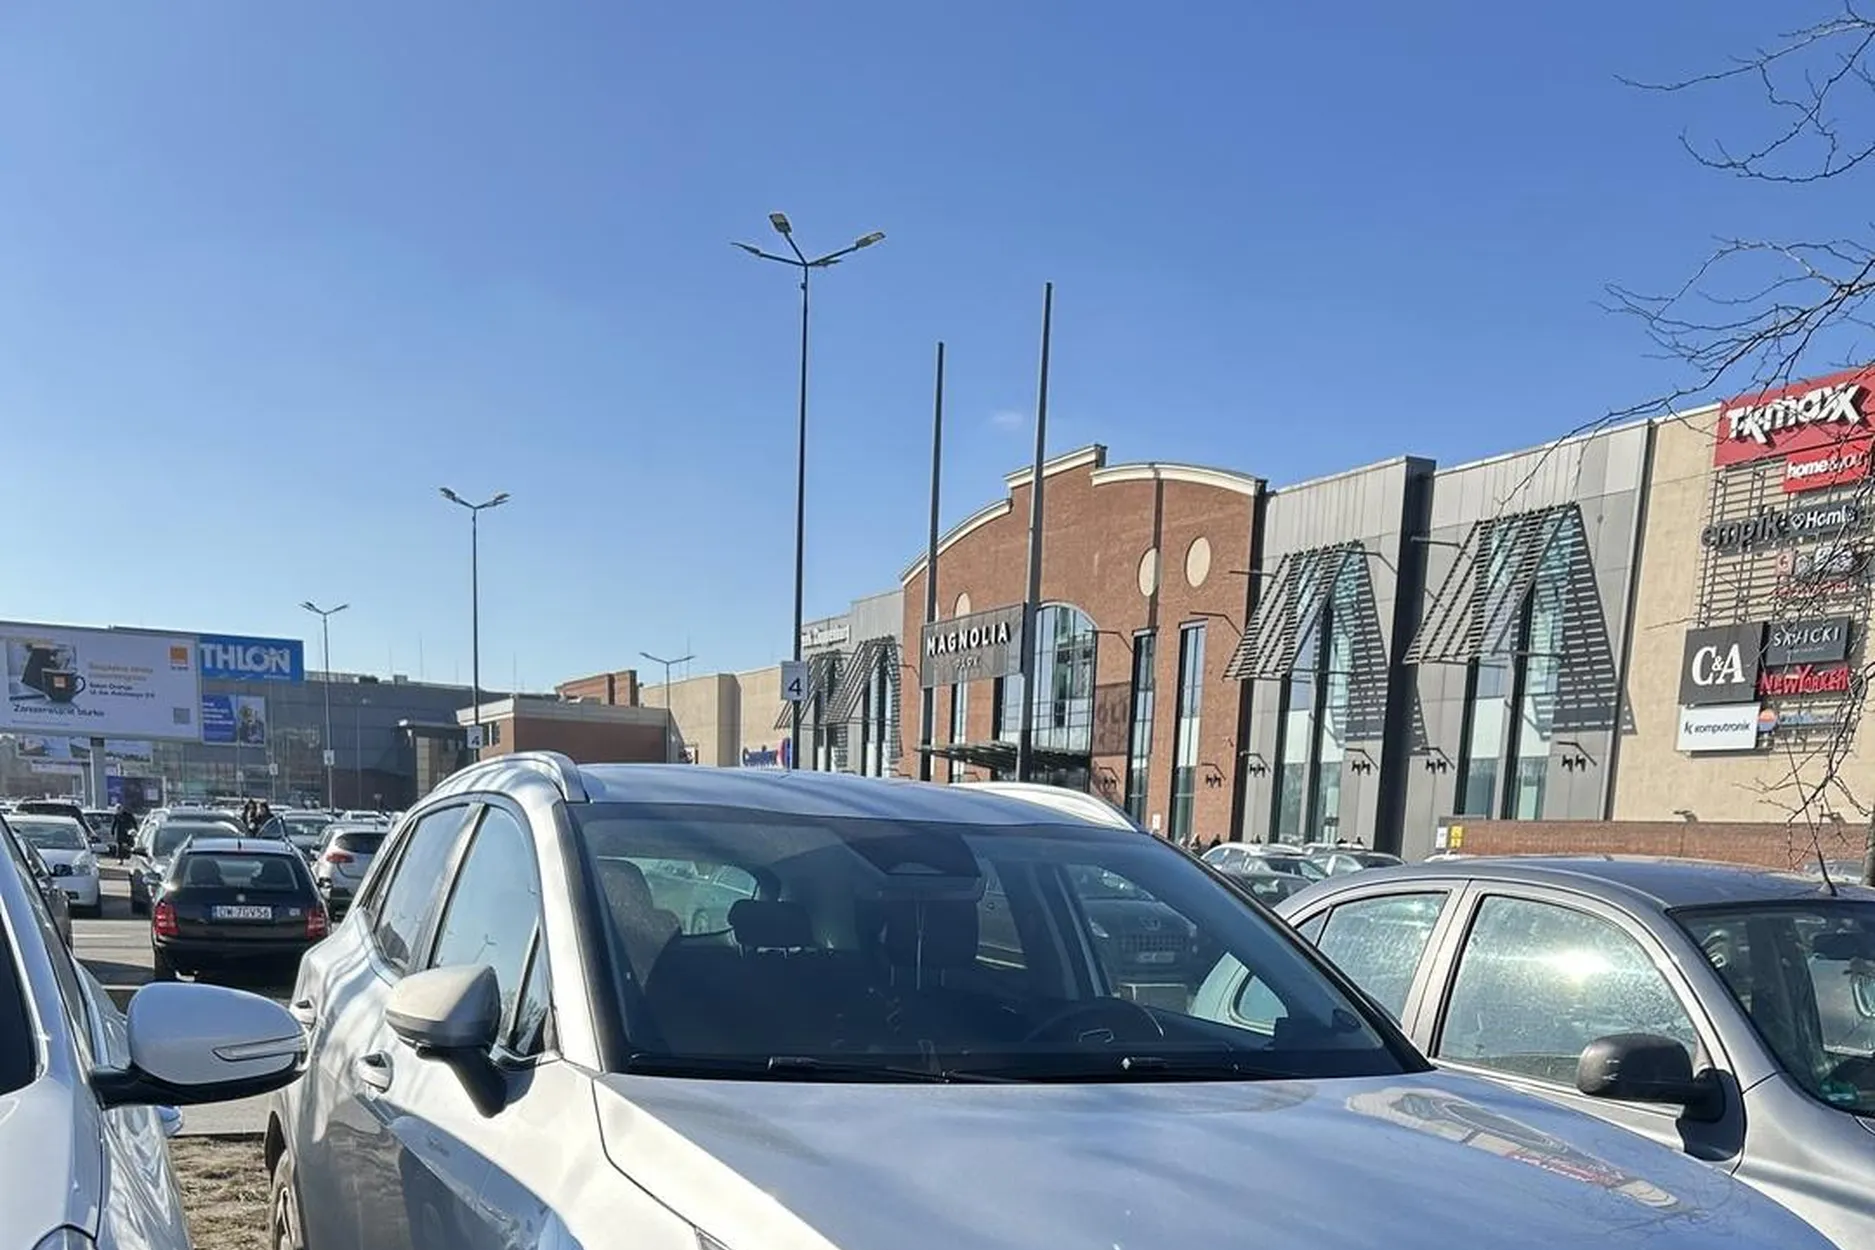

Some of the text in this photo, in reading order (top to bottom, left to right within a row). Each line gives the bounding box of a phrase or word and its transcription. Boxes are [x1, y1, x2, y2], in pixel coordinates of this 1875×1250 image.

[1701, 505, 1785, 548] empik
[926, 620, 1011, 657] MAGNOLIA
[1692, 643, 1746, 686] C&A
[788, 676, 801, 696] 4
